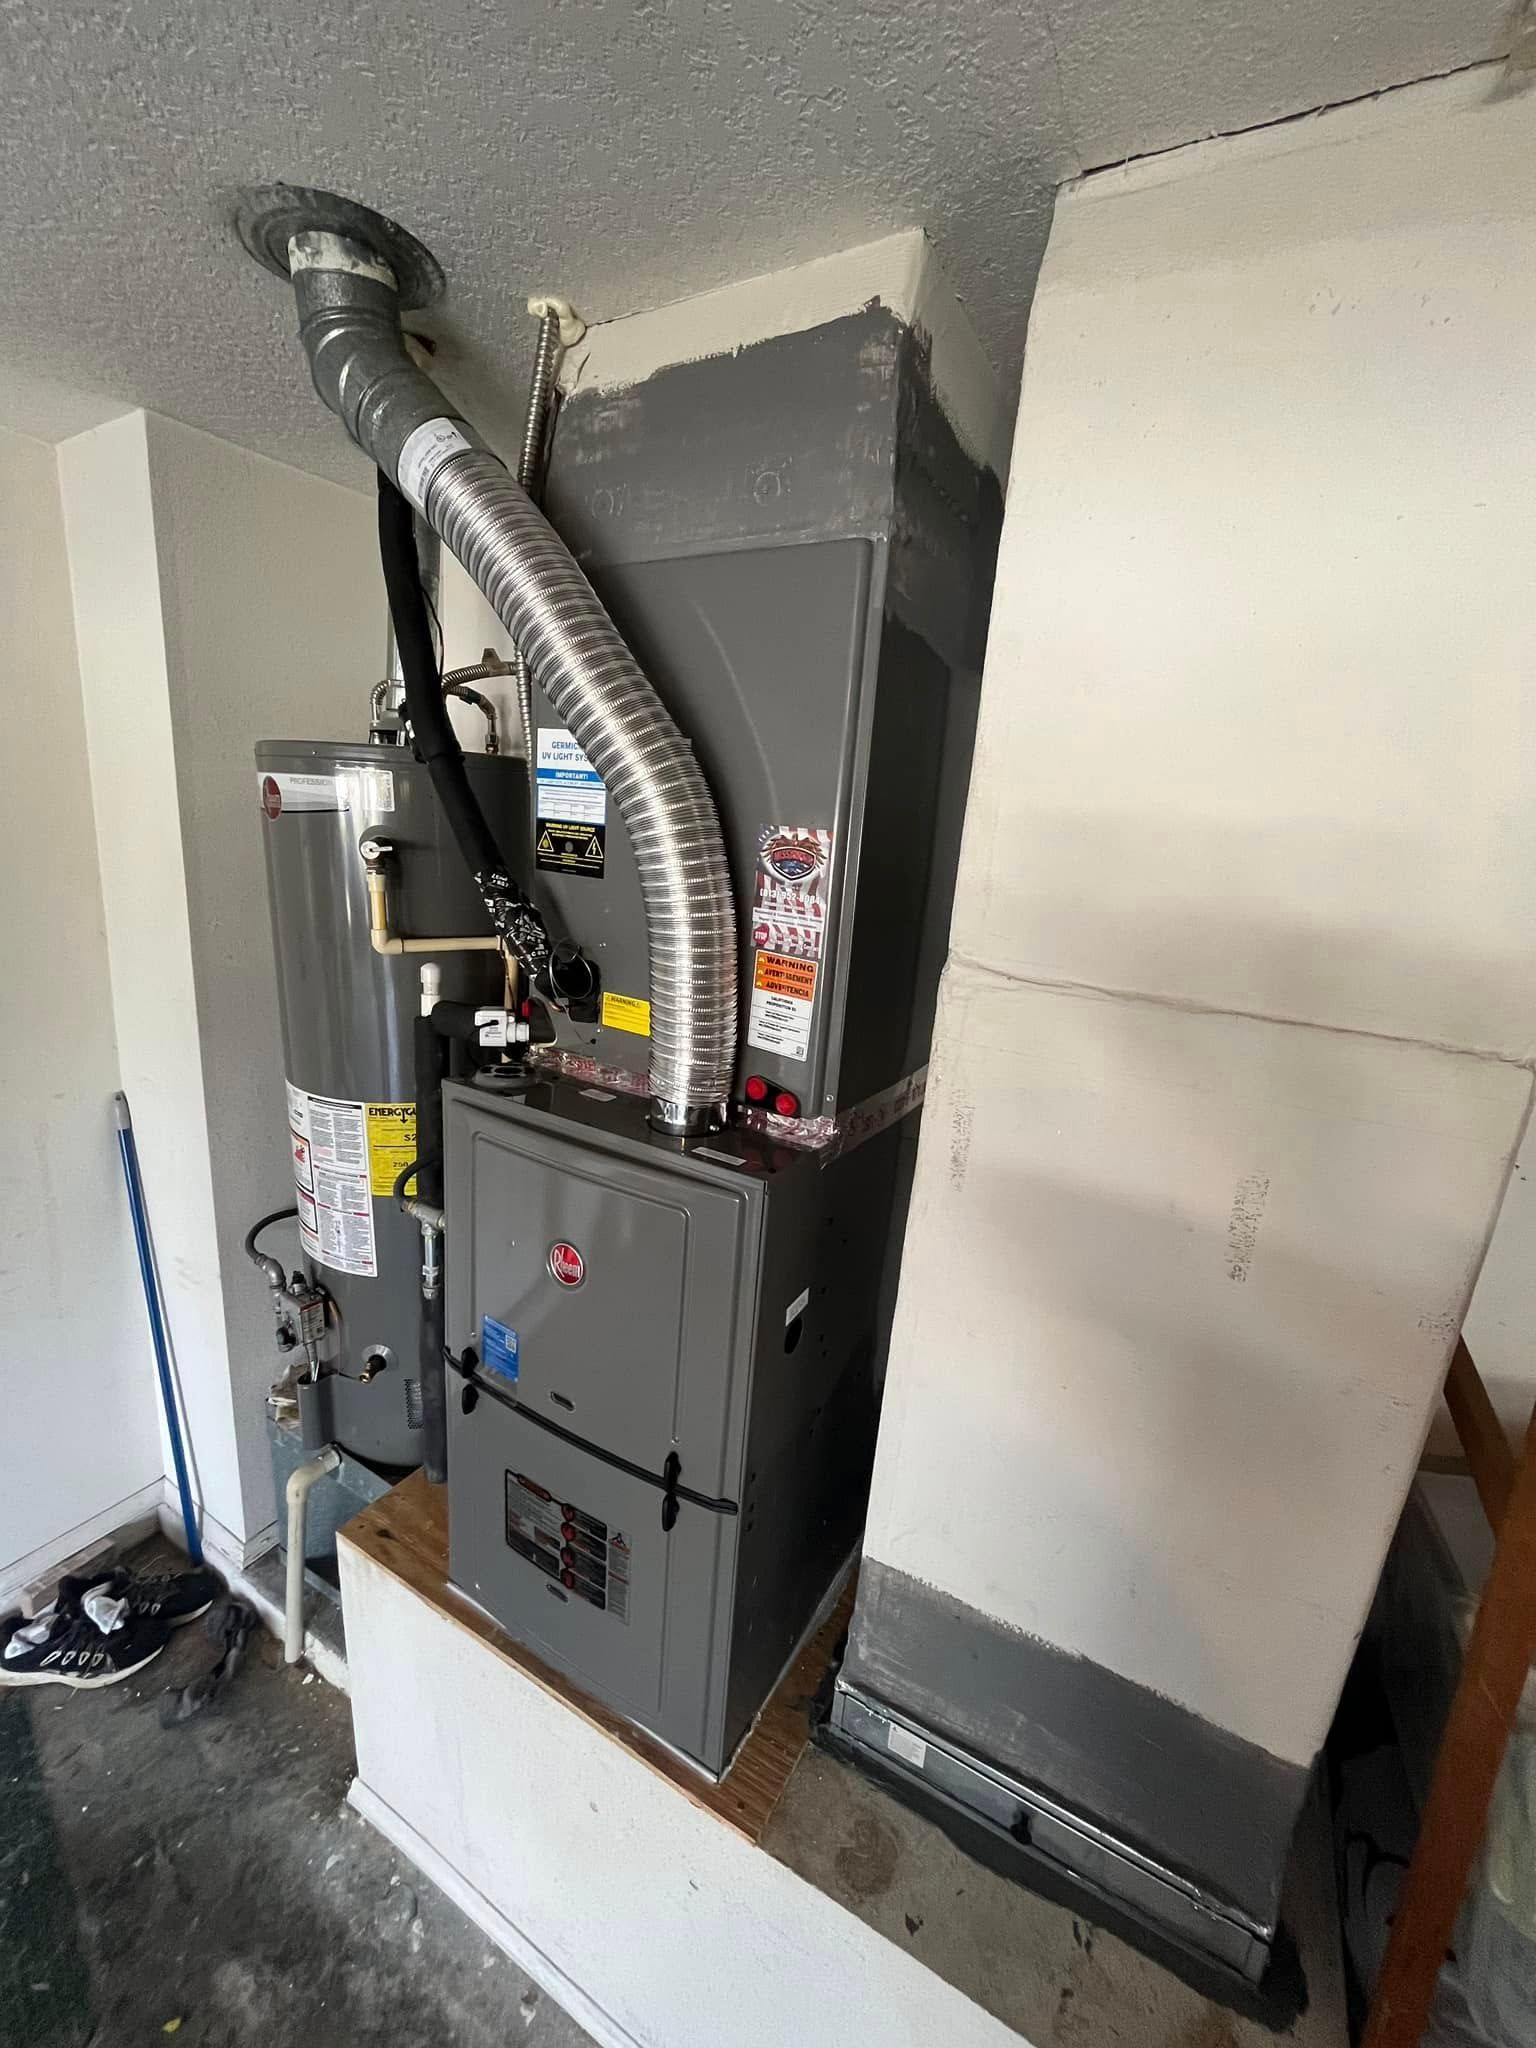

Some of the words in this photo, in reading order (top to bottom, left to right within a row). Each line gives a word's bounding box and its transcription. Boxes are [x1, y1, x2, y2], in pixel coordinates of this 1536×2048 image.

[542, 751, 551, 760] UV
[553, 752, 573, 761] LIGHT
[754, 931, 768, 941] STOP
[766, 956, 814, 973] WARNING
